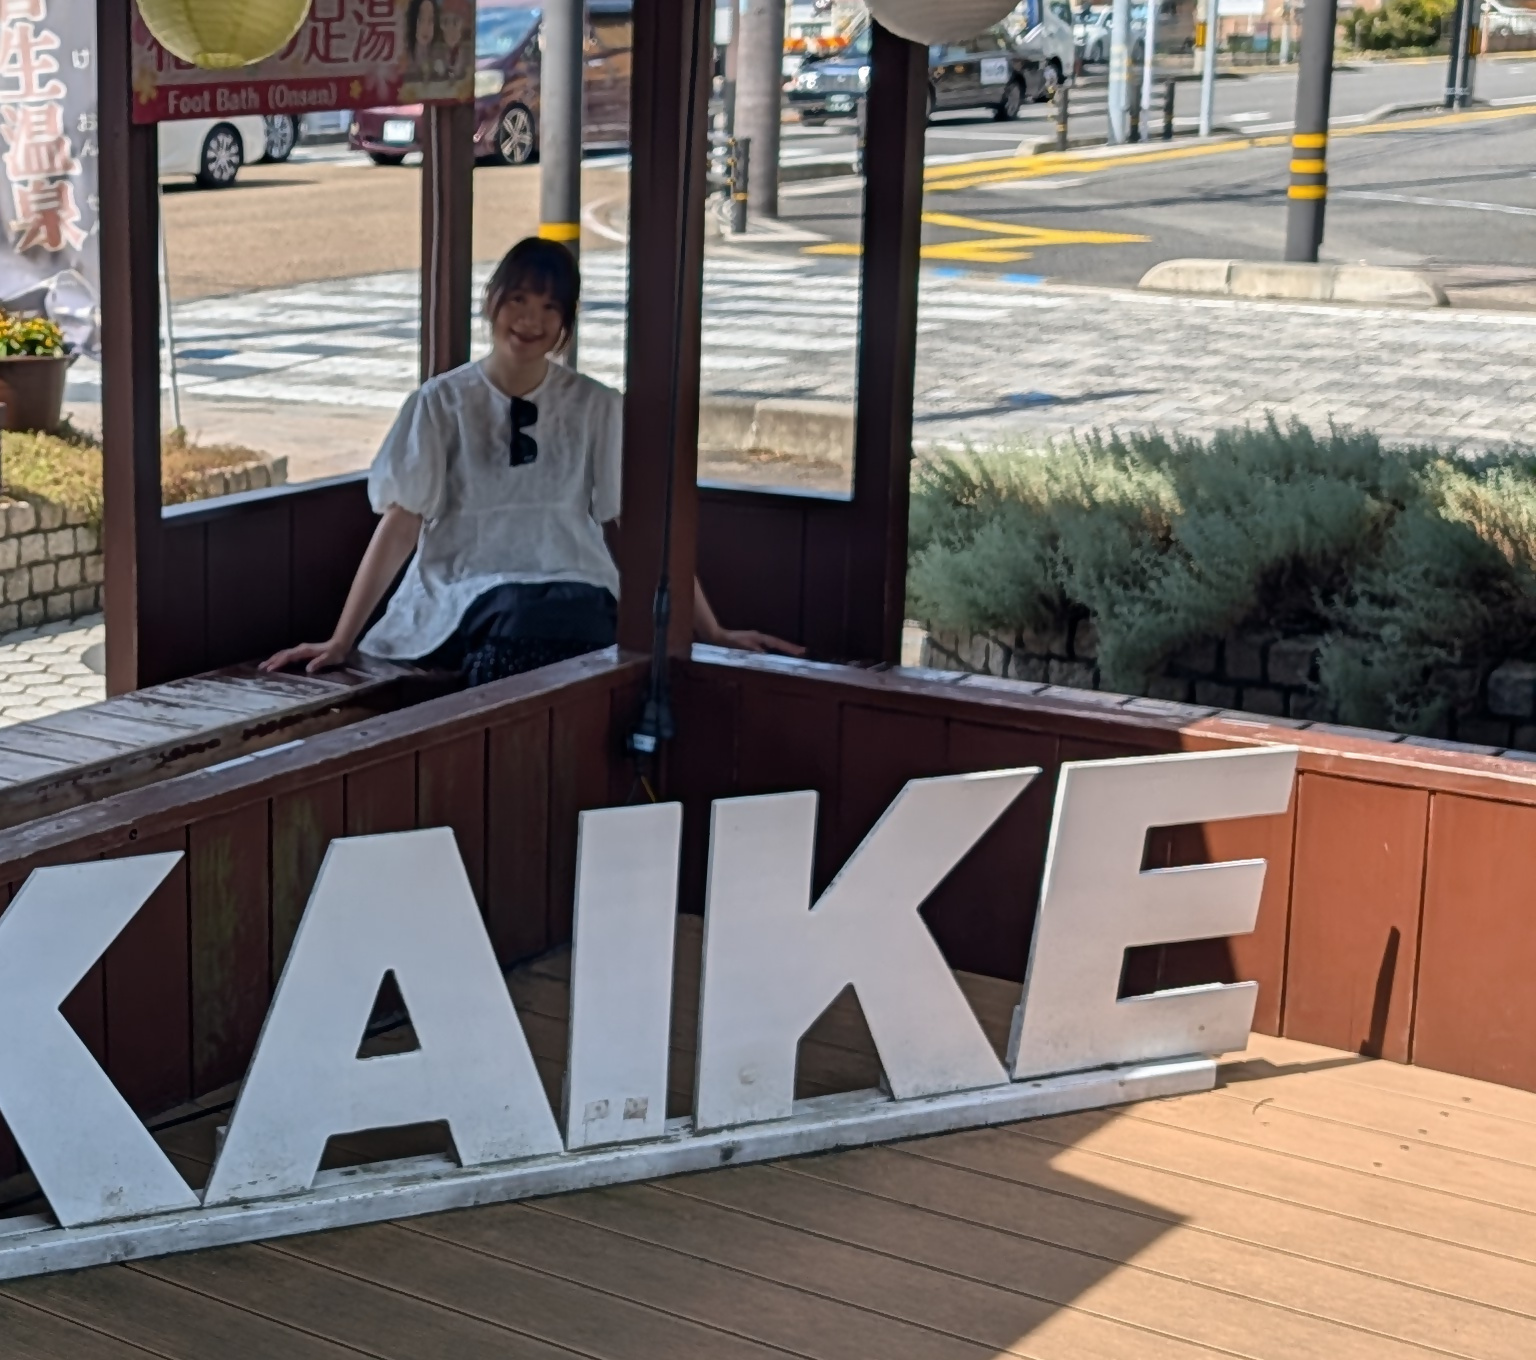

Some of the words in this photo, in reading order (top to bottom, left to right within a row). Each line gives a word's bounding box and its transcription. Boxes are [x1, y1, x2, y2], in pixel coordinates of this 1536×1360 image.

[168, 90, 210, 114] Foot
[216, 86, 260, 111] Bath
[267, 82, 337, 109] (Onsen)
